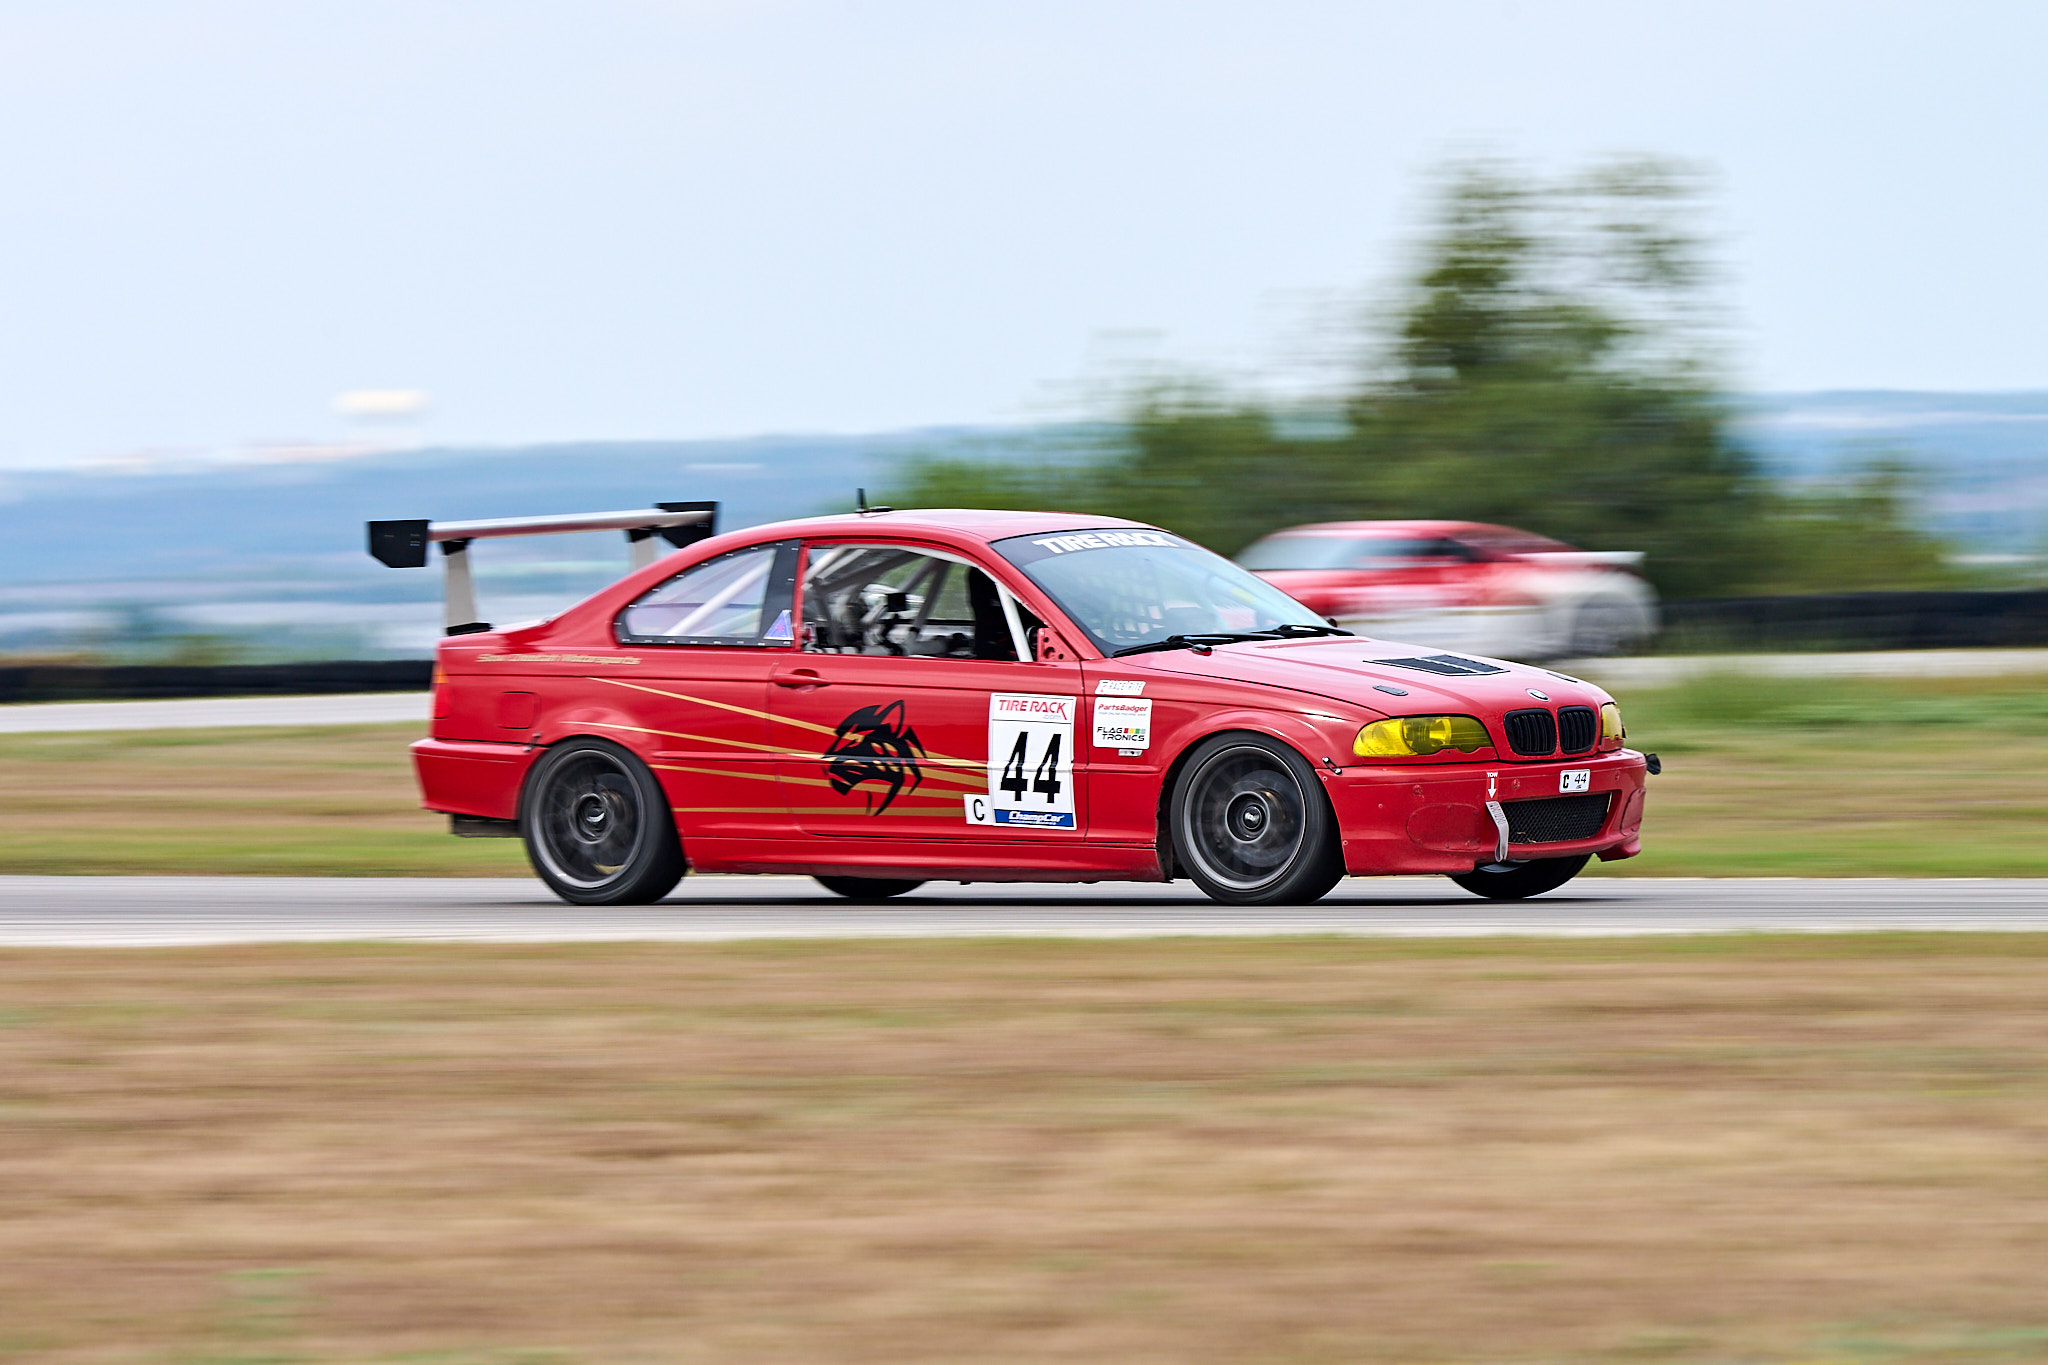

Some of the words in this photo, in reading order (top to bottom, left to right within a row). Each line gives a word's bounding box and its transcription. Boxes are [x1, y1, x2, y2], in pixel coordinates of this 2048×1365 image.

[999, 699, 1029, 712] TIRE
[1029, 700, 1069, 720] RACK
[1097, 703, 1149, 713] PartsBadger
[1096, 726, 1123, 734] FLAG
[1102, 733, 1145, 742] TRONICS
[1000, 731, 1061, 803] 44
[1562, 774, 1570, 789] C
[1574, 772, 1587, 784] 44
[973, 798, 985, 821] C
[1008, 811, 1066, 823] ChampCar
